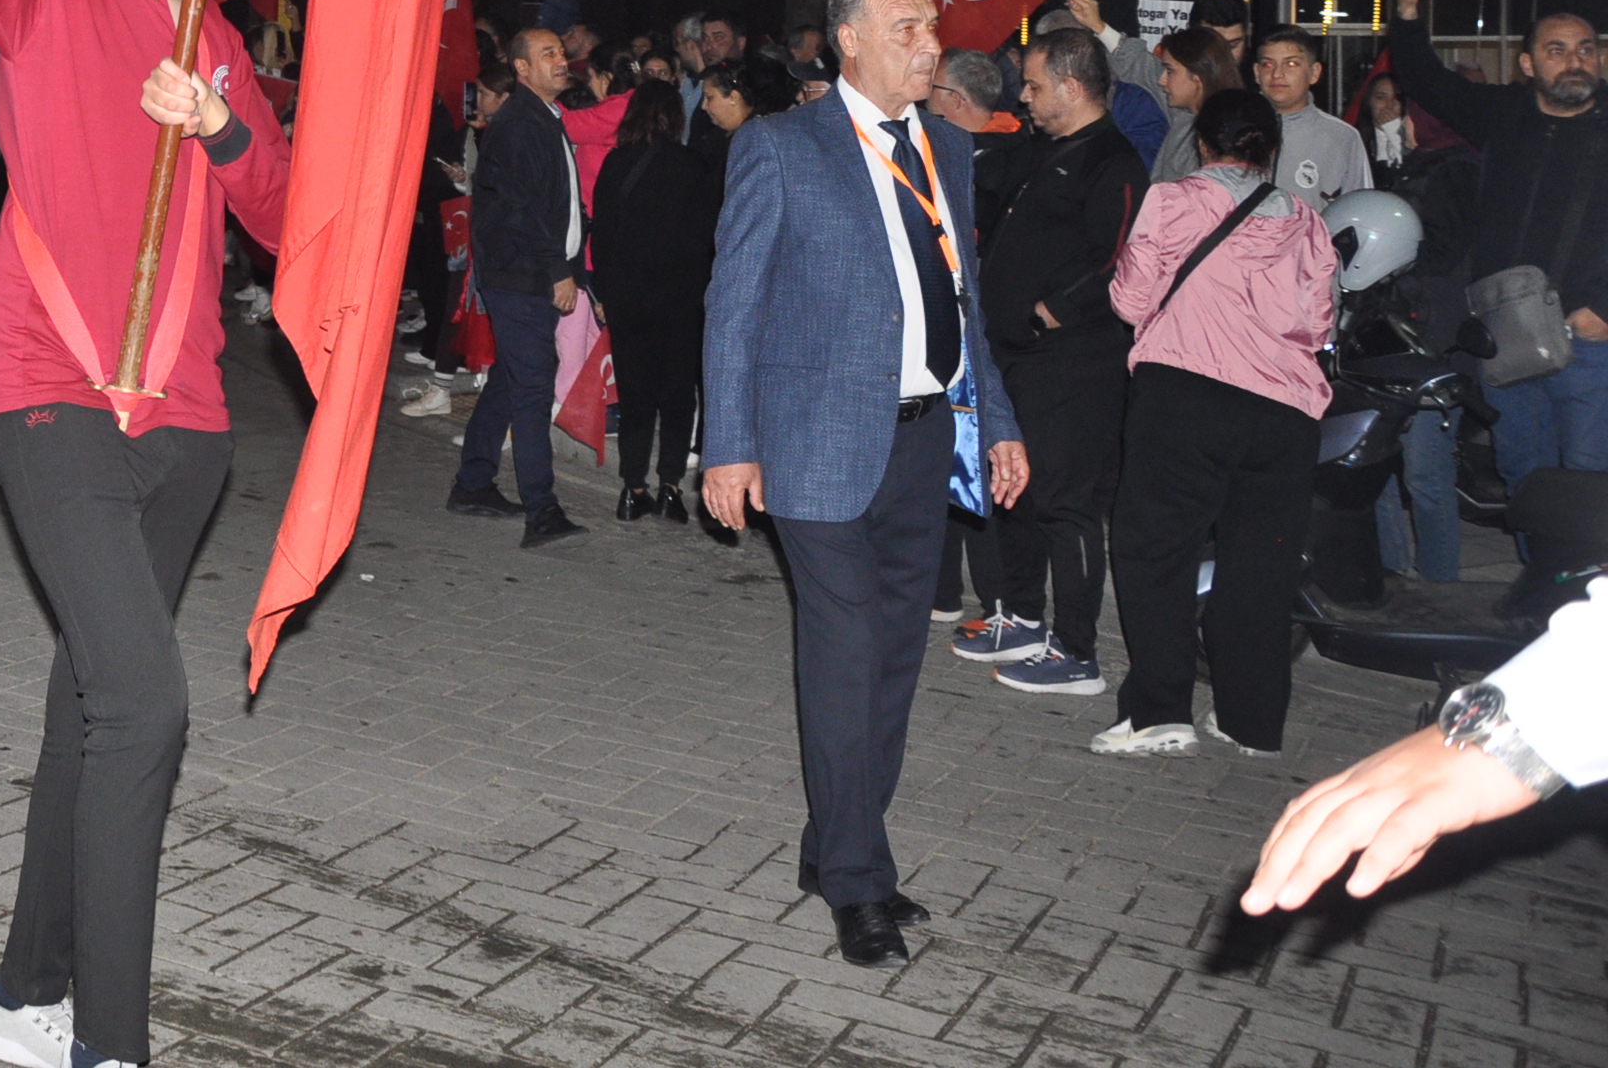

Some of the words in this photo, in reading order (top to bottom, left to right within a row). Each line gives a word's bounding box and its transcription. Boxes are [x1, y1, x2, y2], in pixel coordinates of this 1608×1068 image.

[1137, 8, 1167, 21] togar
[1171, 8, 1190, 21] Ya
[1140, 25, 1166, 35] azar
